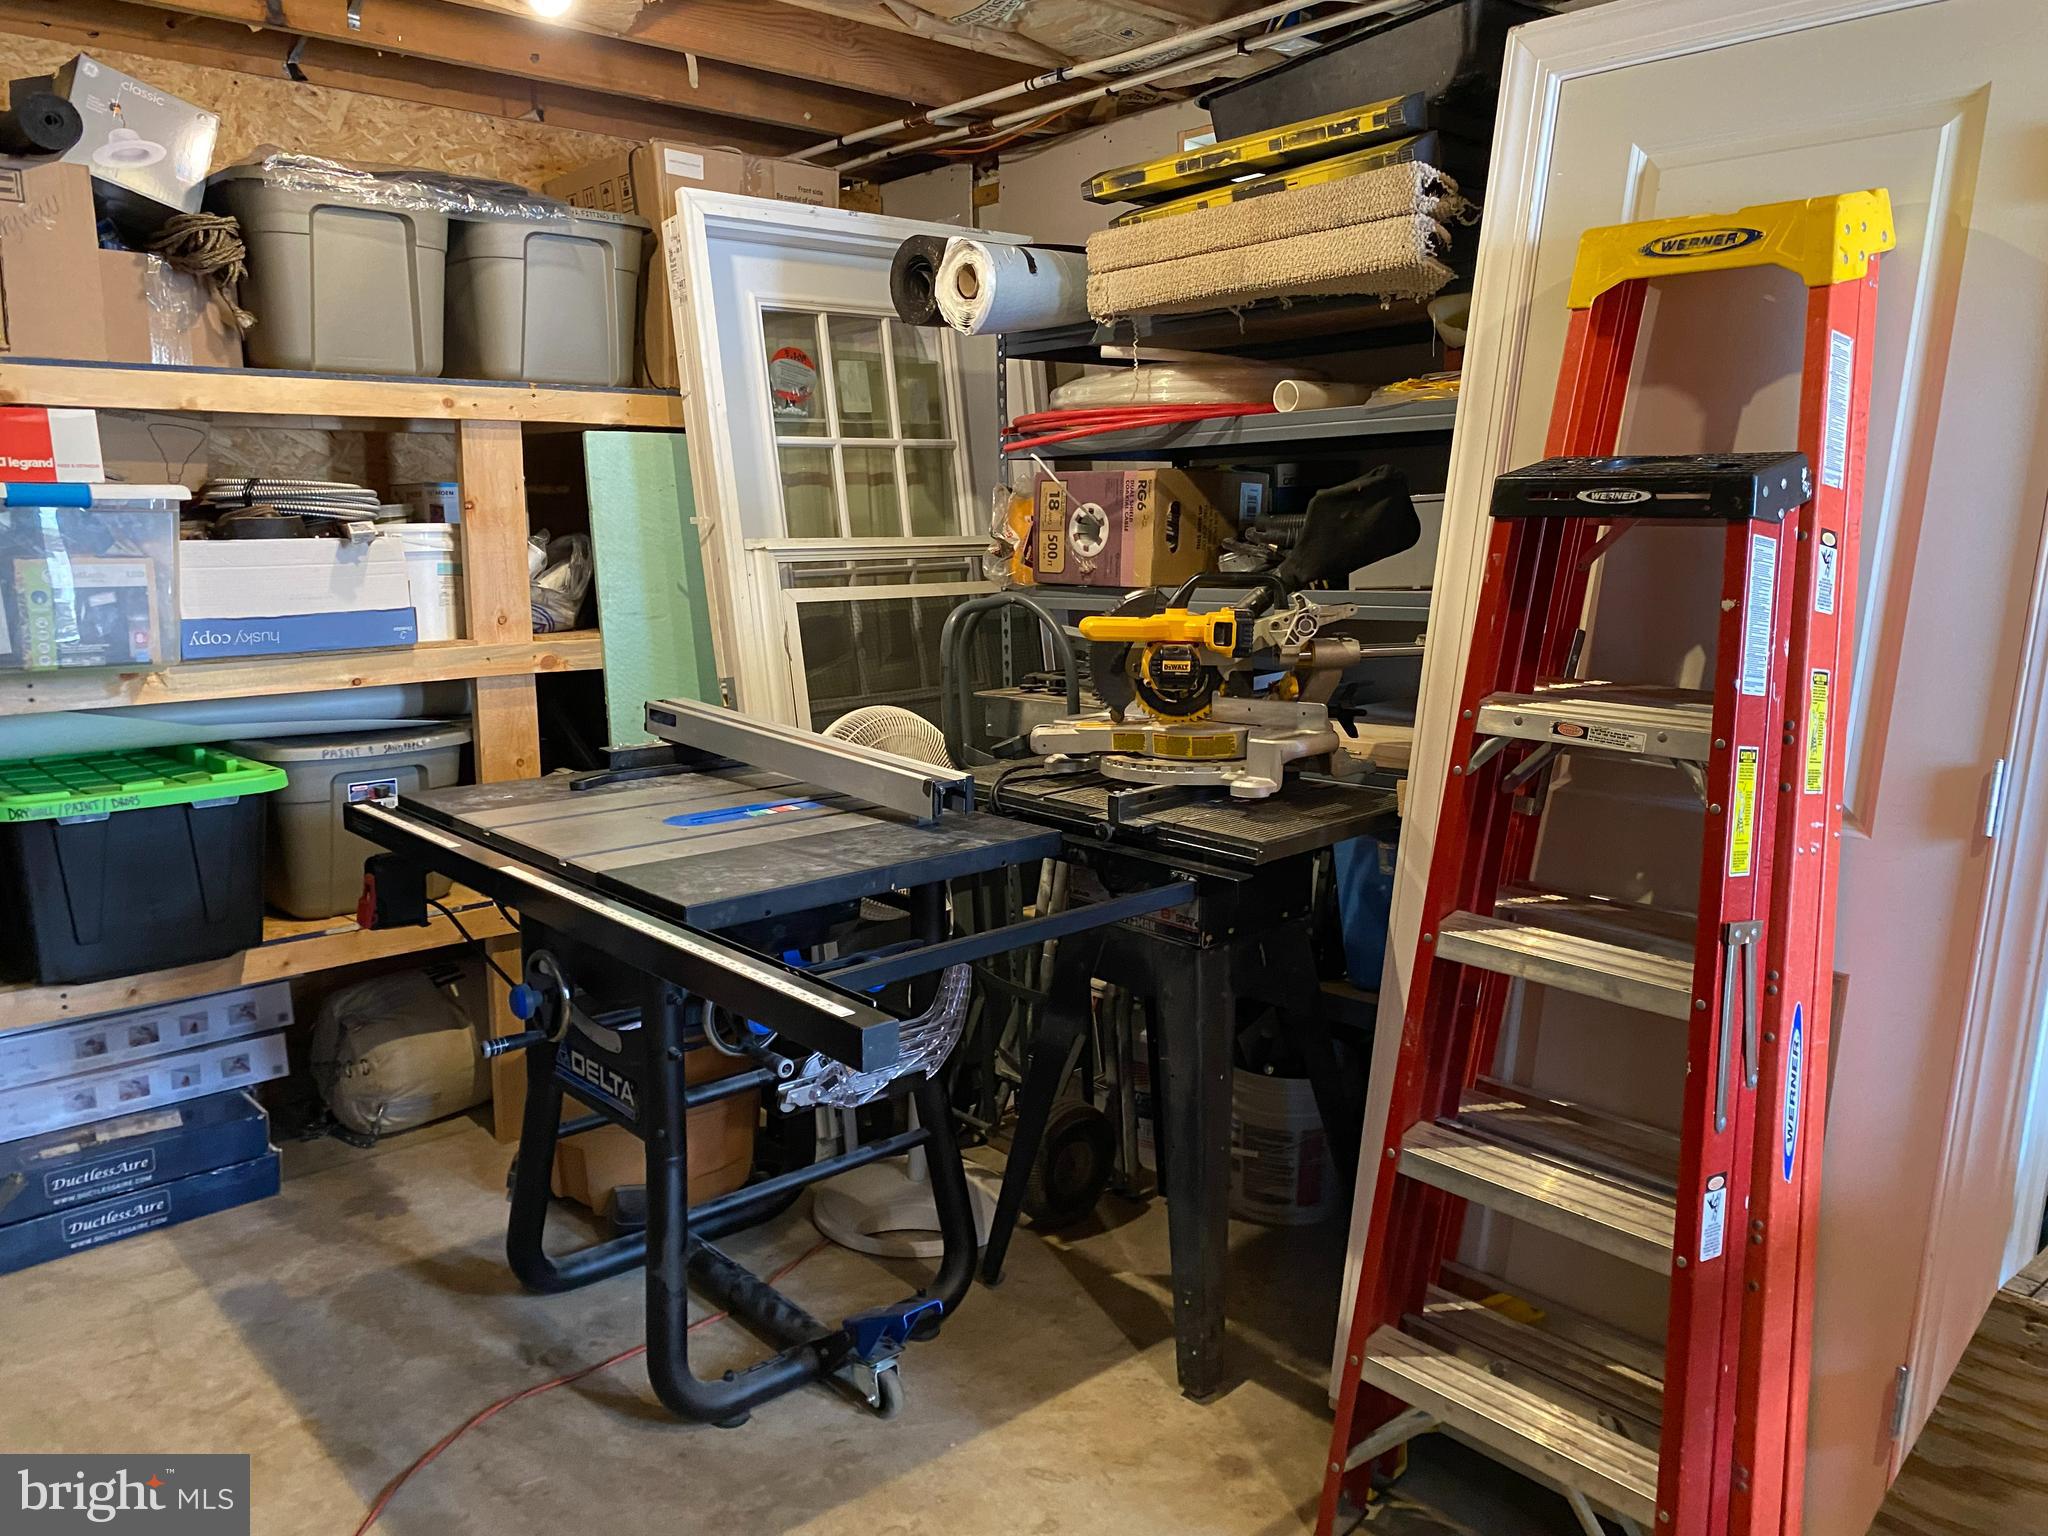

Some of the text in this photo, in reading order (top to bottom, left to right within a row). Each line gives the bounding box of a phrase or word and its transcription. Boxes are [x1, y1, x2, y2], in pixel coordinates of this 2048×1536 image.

[120, 81, 165, 107] classic
[1660, 232, 1738, 253] WERNER
[8, 457, 54, 471] legrand
[1048, 491, 1060, 511] 18
[1136, 480, 1147, 511] RG6
[1590, 491, 1638, 500] WERNER
[1047, 534, 1058, 560] 500
[188, 628, 280, 646] husky copy
[321, 748, 361, 759] PAINT
[570, 1050, 635, 1107] DELTA
[1786, 1040, 1800, 1144] WERNER
[51, 1158, 149, 1192] DuctlessAire
[69, 1200, 165, 1235] DuctlessAire
